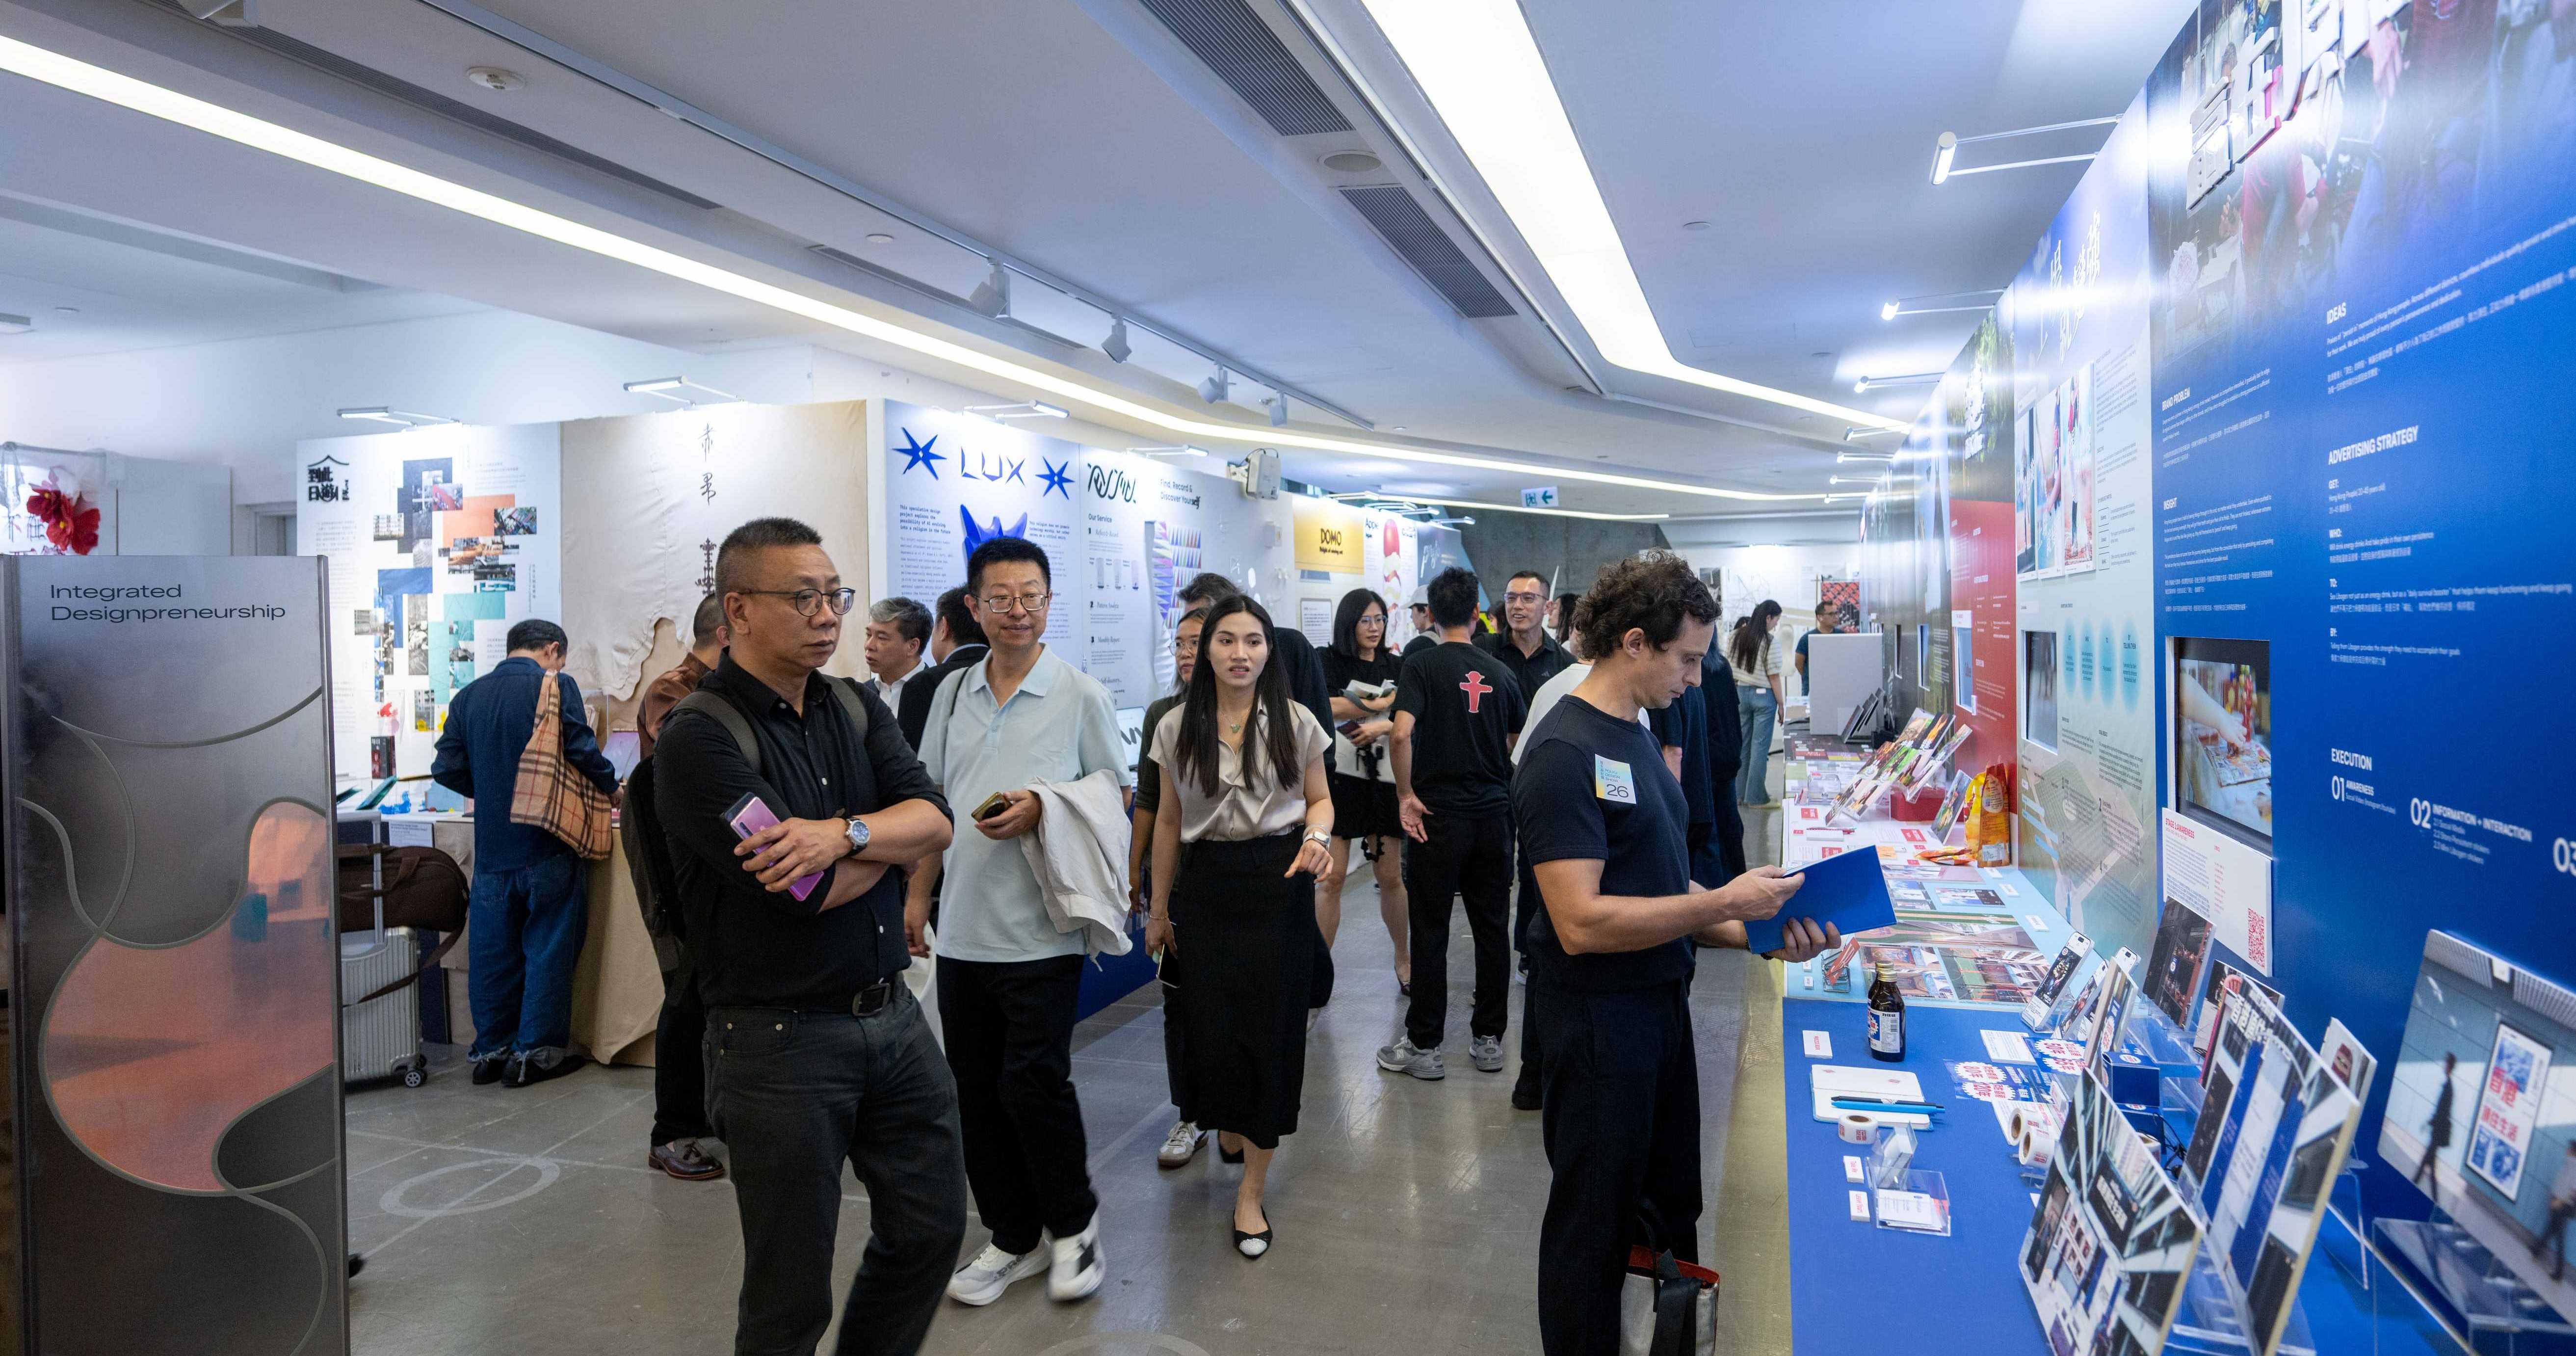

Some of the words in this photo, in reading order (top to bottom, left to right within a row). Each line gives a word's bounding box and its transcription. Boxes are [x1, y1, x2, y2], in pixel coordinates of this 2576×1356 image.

[2327, 302, 2346, 324] IDEAS
[2162, 396, 2174, 411] BRAND
[2174, 387, 2190, 405] PROBLEM
[2328, 438, 2376, 465] ADVERTISING
[2376, 425, 2419, 452] STRATEGY
[961, 446, 1026, 488] LUX
[1173, 481, 1188, 491] Record
[2329, 479, 2339, 490] GET:
[1160, 492, 1181, 502] Discover
[1182, 496, 1201, 509] Yourself
[2163, 497, 2178, 510] INSIGHT
[1097, 514, 1112, 523] Service
[1320, 528, 1342, 546] DOMO
[2329, 528, 2342, 539] WHO:
[51, 584, 181, 602] Integrated
[52, 604, 286, 623] Designpreneurship
[2331, 748, 2372, 771] EXECUTION
[1606, 784, 1629, 798] 26
[2332, 775, 2345, 802] 01
[2346, 780, 2374, 796] AWARENESS
[2166, 818, 2174, 828] STAGE
[2410, 798, 2432, 829] 02
[2433, 803, 2476, 826] INFORMATION
[2483, 817, 2532, 843] INTERACTION
[2044, 1042, 2066, 1055] 50年
[1963, 1065, 1983, 1079] 80年
